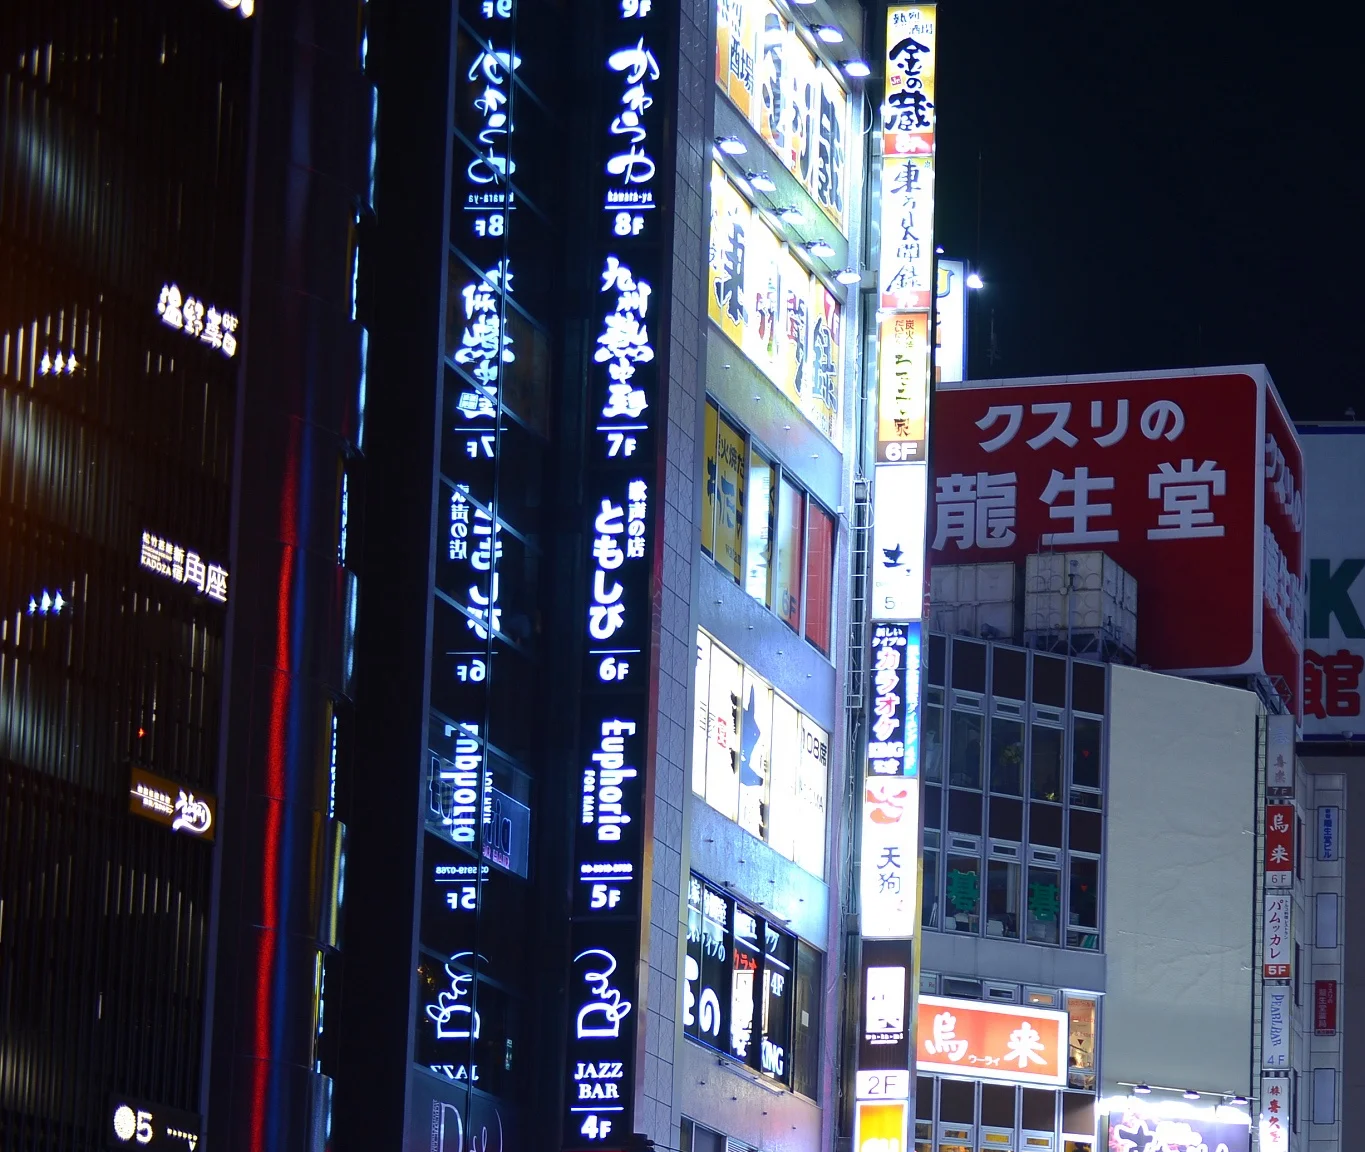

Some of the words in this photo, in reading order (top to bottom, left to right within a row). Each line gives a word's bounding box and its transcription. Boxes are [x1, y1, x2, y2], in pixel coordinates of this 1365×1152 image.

[885, 37, 935, 131] 金の蔵
[608, 36, 660, 185] かわらや
[613, 212, 645, 237] 8F
[974, 398, 1186, 454] クスリの
[607, 436, 638, 459] 7F
[885, 443, 918, 461] 6F
[930, 457, 1228, 551] 龍生堂
[627, 479, 648, 559] 歌声の店
[182, 551, 229, 602] 角座
[588, 498, 626, 642] ともしび
[599, 656, 631, 683] 6F
[873, 647, 902, 742] カラオケ
[592, 719, 638, 842] Euphoria
[1270, 787, 1288, 797] 7F
[1268, 812, 1290, 864] 烏来
[876, 845, 901, 895] 天狗
[1271, 873, 1287, 885] 6F
[590, 884, 622, 909] 5F
[1268, 900, 1284, 959] パムッカレ
[1267, 965, 1287, 977] 5F
[769, 972, 785, 998] 4F
[1270, 993, 1284, 1026] PEARL
[1270, 1026, 1283, 1047] BAR
[574, 1062, 624, 1080] JAZZ
[967, 1054, 1001, 1067] ウーライ
[1266, 1055, 1286, 1066] 4F
[578, 1083, 620, 1100] BAR
[867, 1075, 898, 1095] 2F
[580, 1115, 613, 1139] 4F
